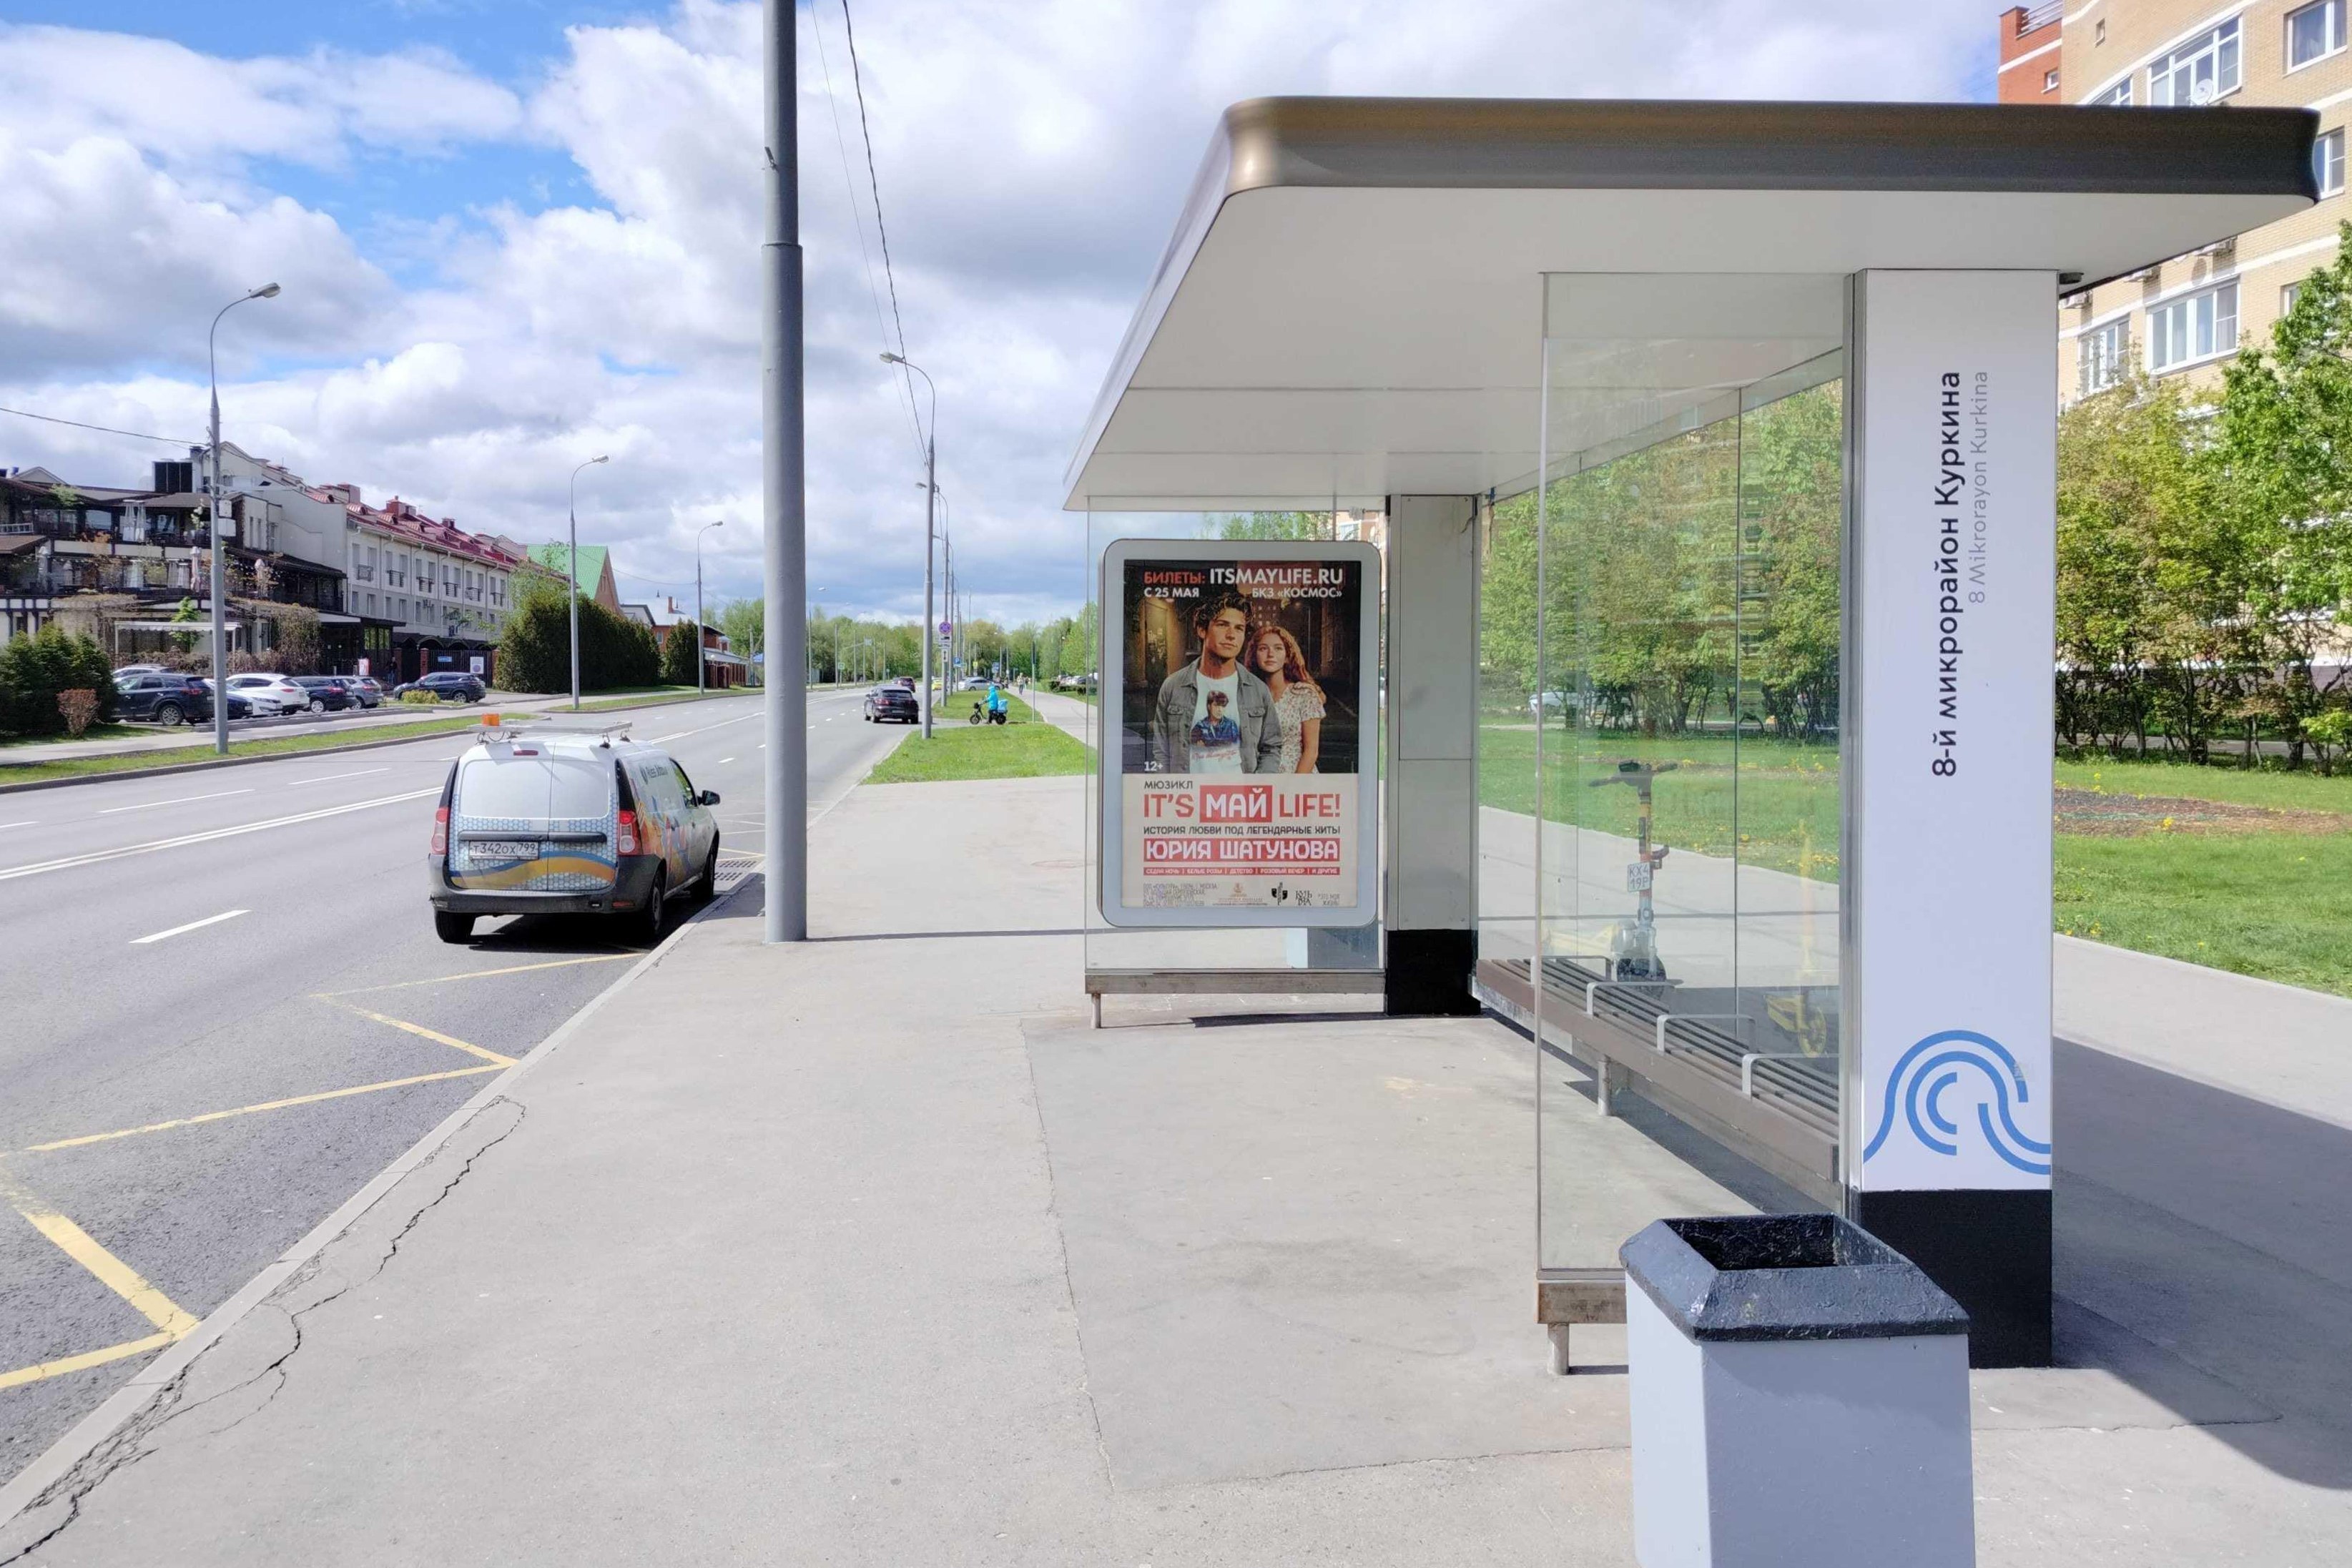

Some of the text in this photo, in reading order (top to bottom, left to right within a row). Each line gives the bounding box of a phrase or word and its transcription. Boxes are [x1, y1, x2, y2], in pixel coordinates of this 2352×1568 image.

[1968, 370, 1991, 603] 8 Mikrorayon Kurkina
[1143, 568, 1343, 585] БИЛЕТЫ: ITSMAYLIFE.RU
[1932, 371, 1966, 776] 8-й микрорайон Куркина
[1154, 587, 1170, 598] 25
[1172, 587, 1200, 598] МАЯ
[1251, 587, 1342, 598] БКЗ «КОСМОС»
[1143, 760, 1164, 772] 12+
[1143, 780, 1194, 790] МЮЗИКЛ
[1143, 787, 1341, 819] IT'S МАЙ LIFE!
[1143, 826, 1341, 836] ИСТОРИЯ ЛЮБВИ ПОД ЛЕГЕНДАРНЫЕ ХИТЫ
[1146, 839, 1339, 860] ЮРИЯ ШАТУНОВА
